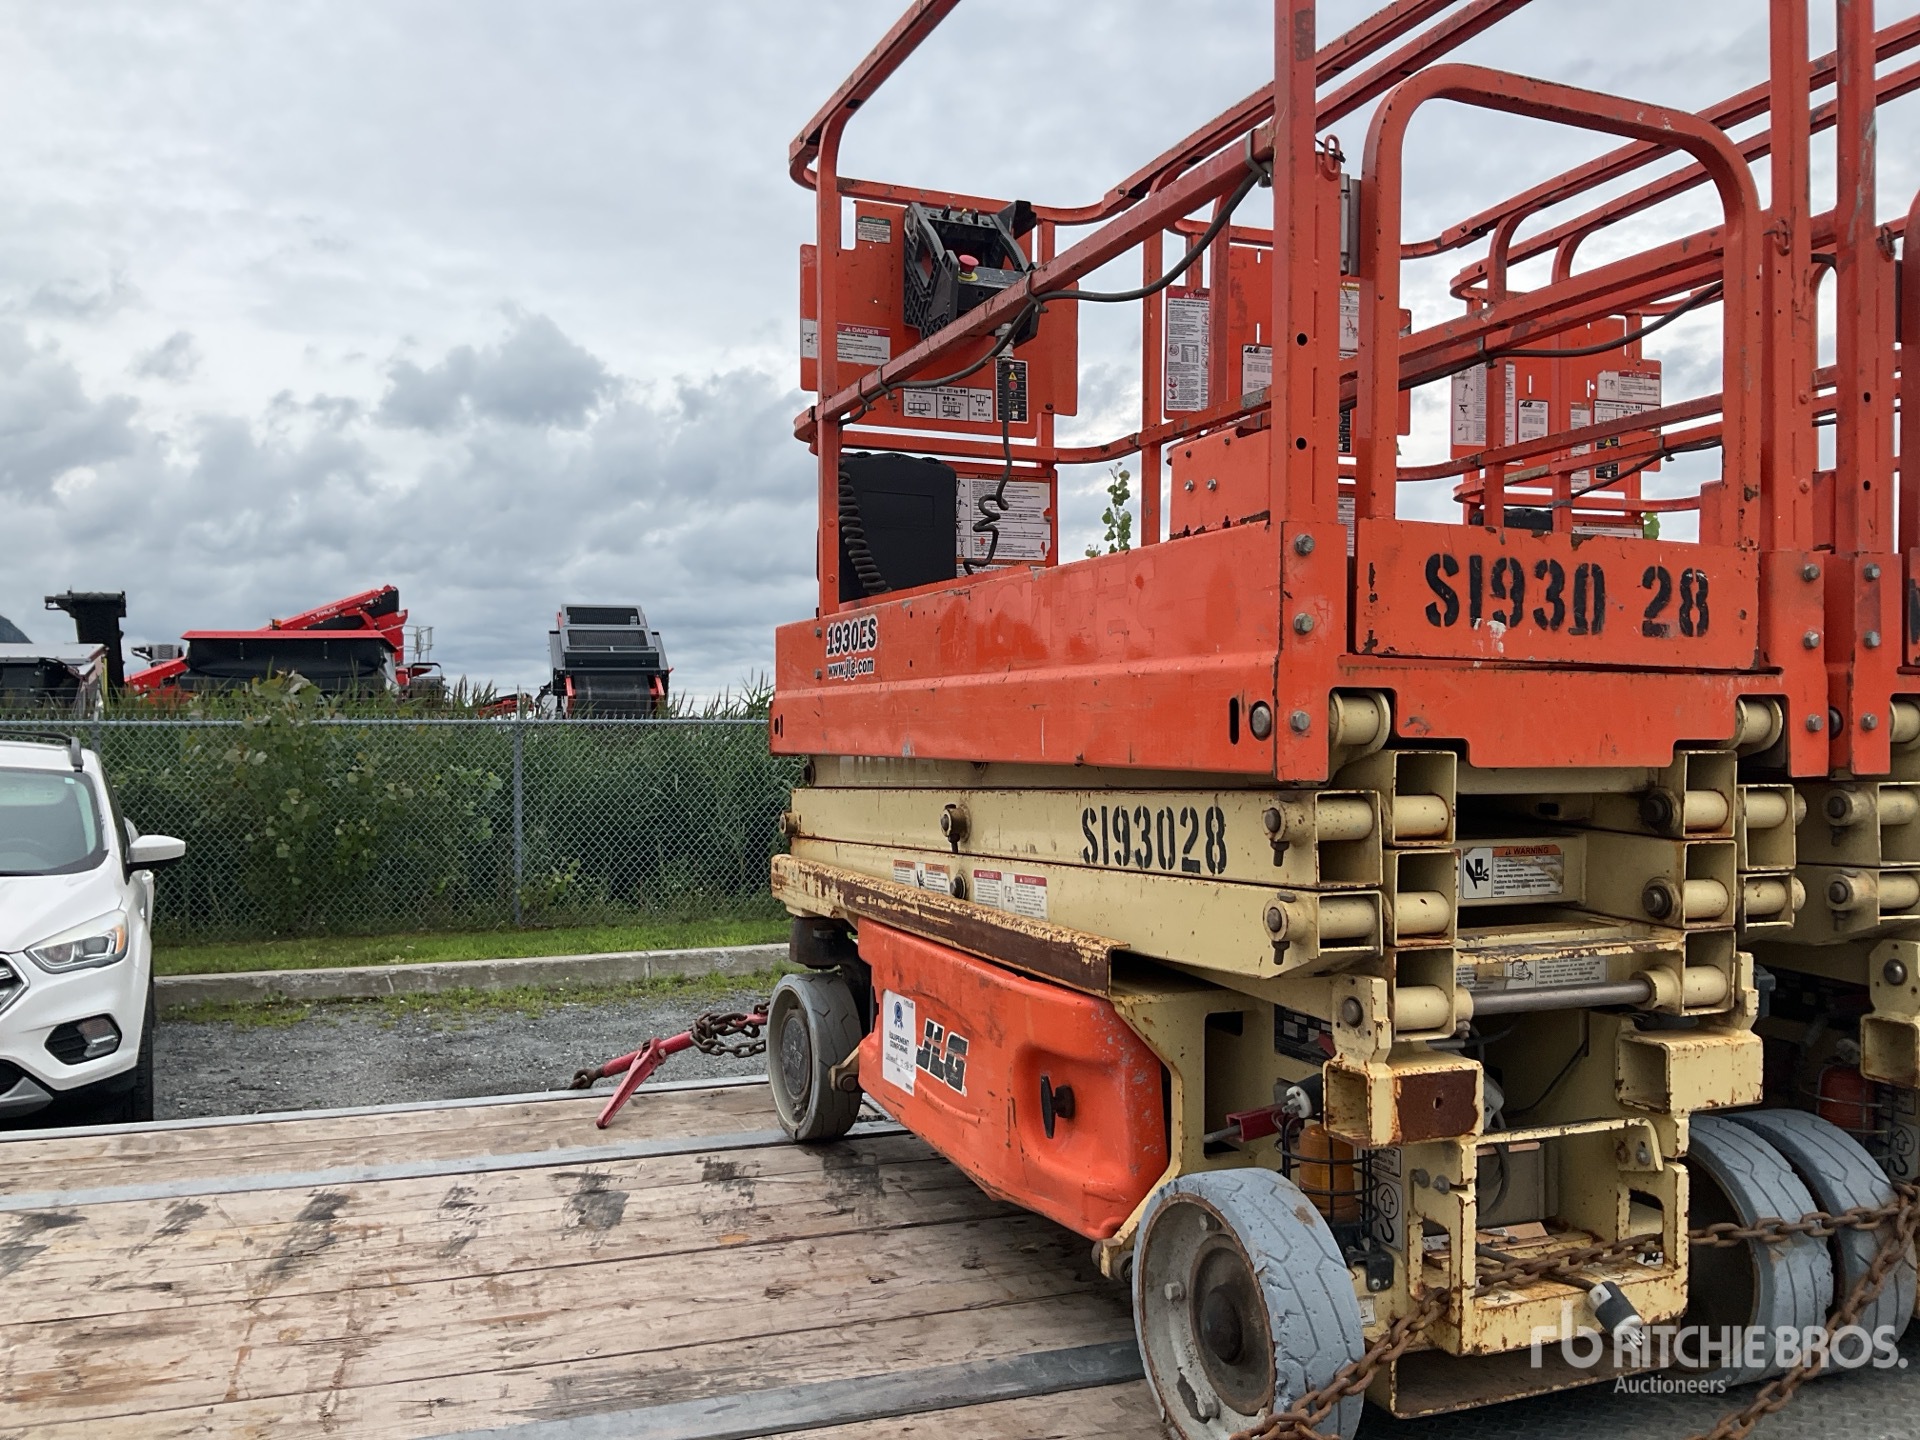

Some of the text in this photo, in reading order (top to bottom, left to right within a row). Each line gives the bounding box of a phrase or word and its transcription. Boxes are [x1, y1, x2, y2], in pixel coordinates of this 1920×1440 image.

[851, 327, 879, 336] DANGER
[1642, 564, 1710, 638] 28
[826, 616, 878, 656] 1930ES
[828, 658, 875, 679] www.jlg.com
[1514, 846, 1549, 855] WARNING
[916, 1017, 970, 1095] JLG
